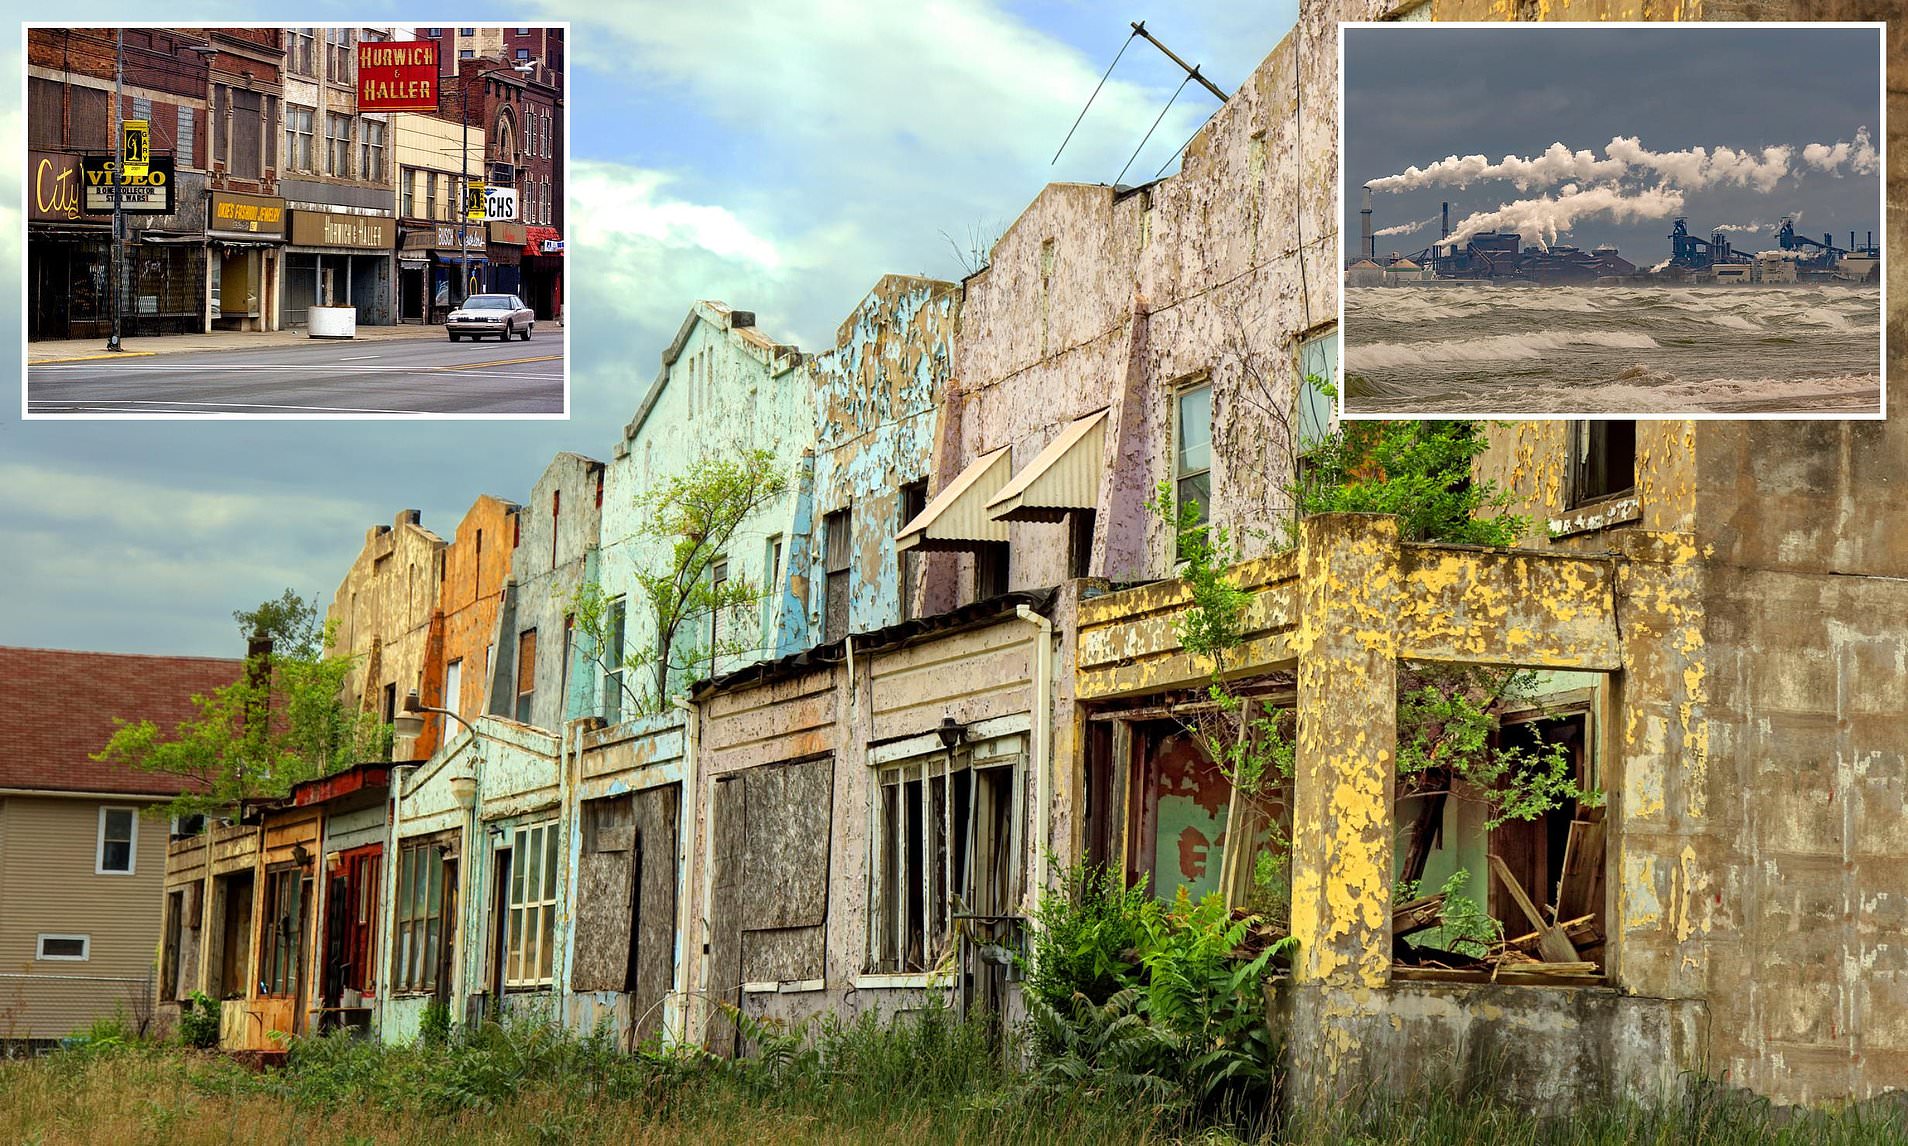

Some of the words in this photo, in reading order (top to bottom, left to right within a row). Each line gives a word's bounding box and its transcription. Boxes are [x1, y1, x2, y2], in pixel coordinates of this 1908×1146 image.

[360, 47, 433, 69] HURWICH
[394, 69, 400, 78] &
[364, 79, 430, 101] HALLER
[36, 158, 82, 220] City
[324, 214, 351, 245] HURWICH
[358, 219, 382, 246] HALLER
